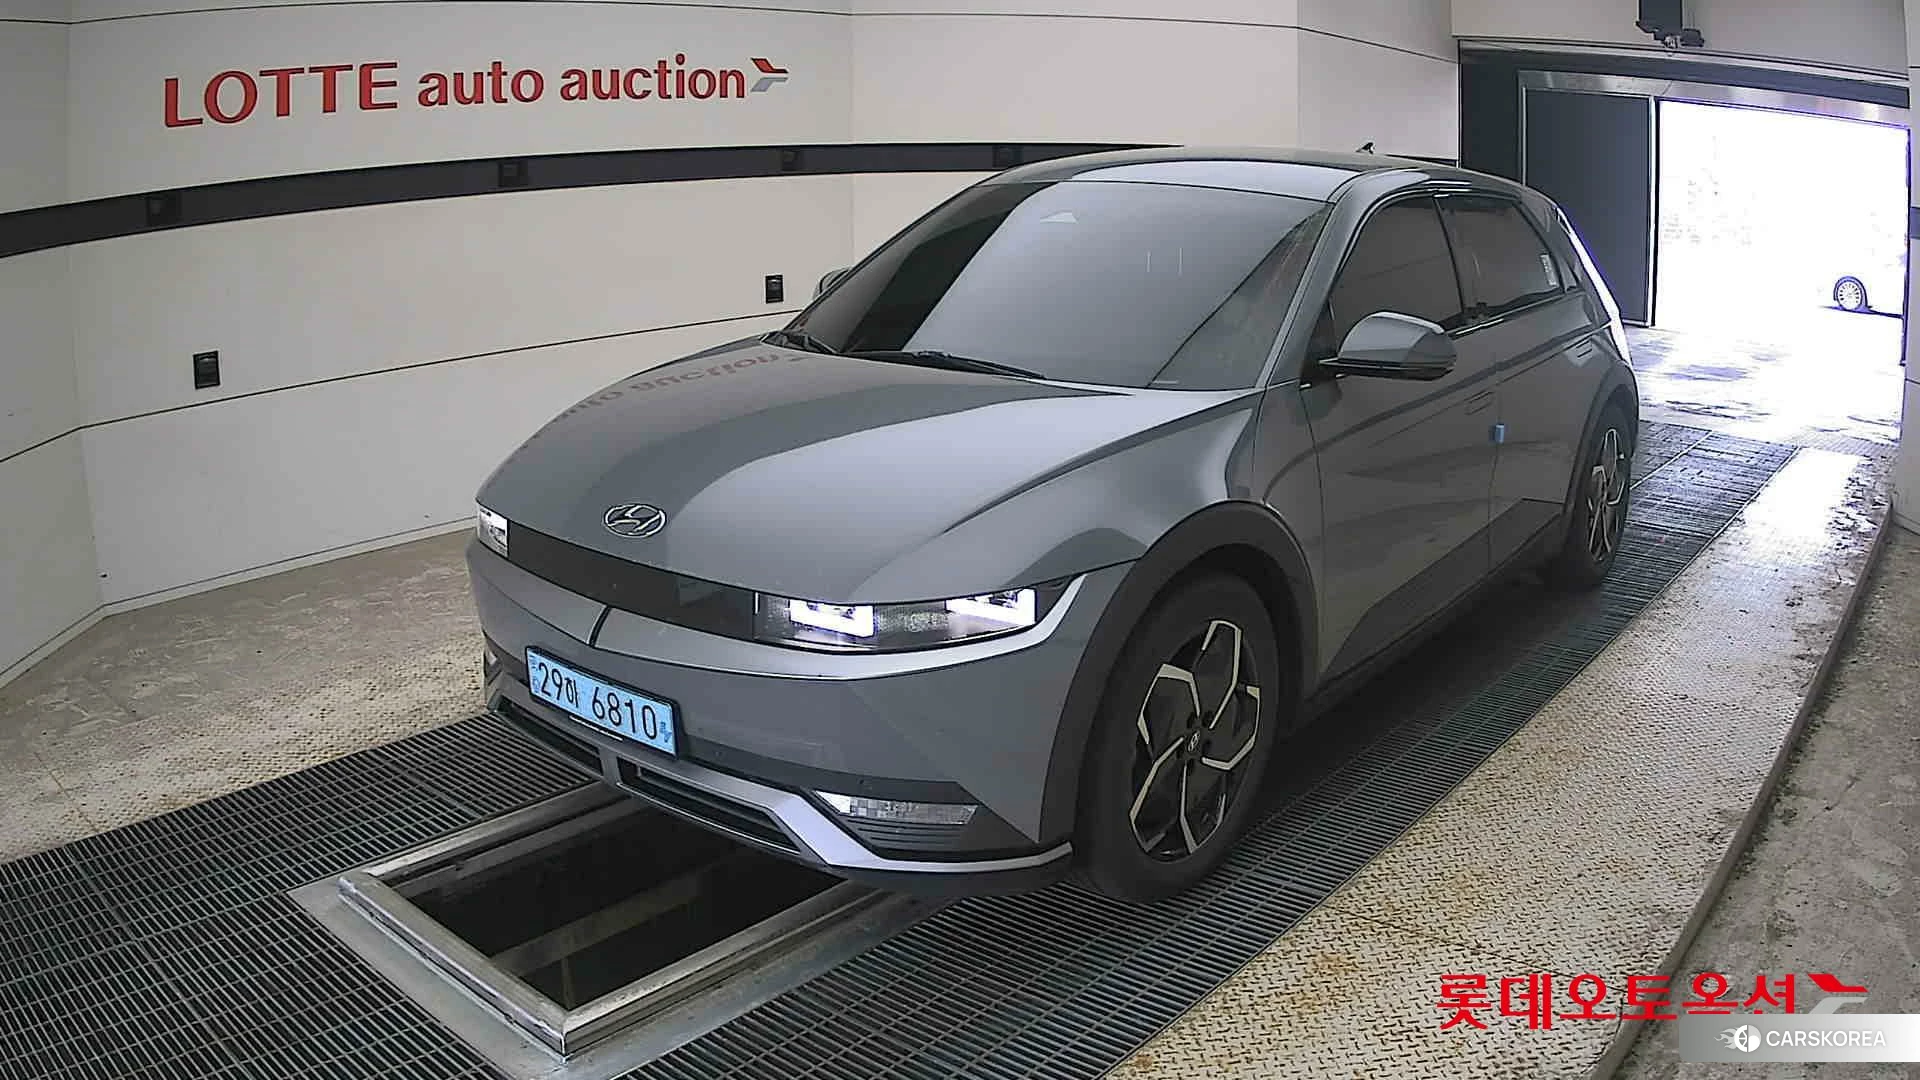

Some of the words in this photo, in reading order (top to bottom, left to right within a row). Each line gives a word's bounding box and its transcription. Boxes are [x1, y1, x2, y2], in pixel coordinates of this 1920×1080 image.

[164, 61, 399, 128] LOTTE
[417, 60, 546, 107] auto
[559, 52, 746, 101] auction
[591, 686, 657, 740] 6810
